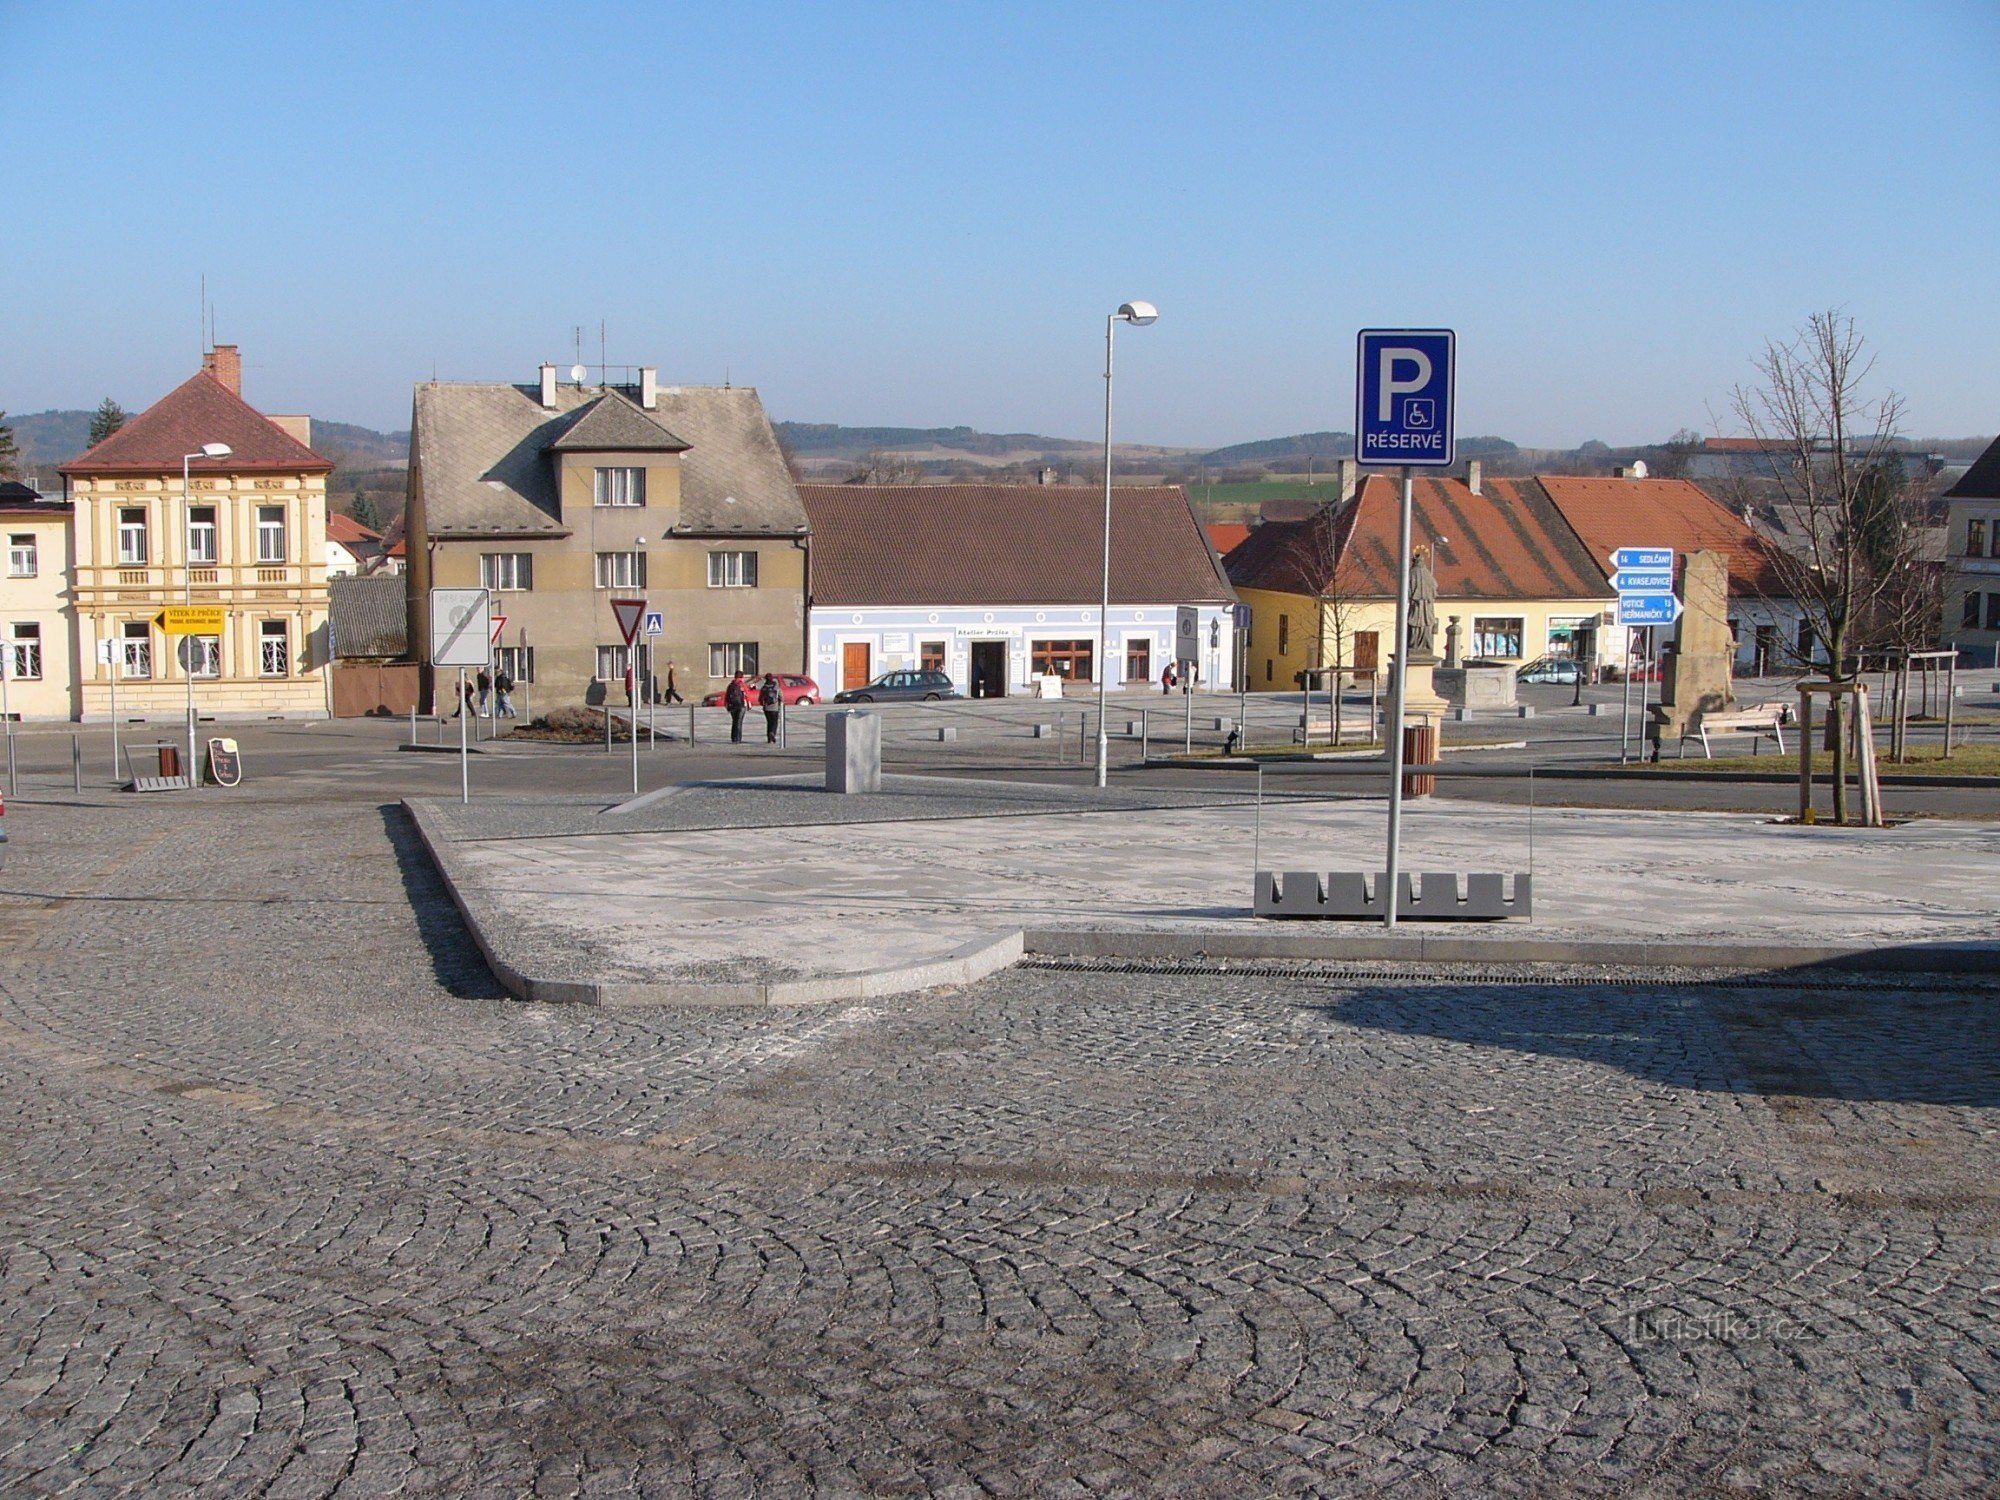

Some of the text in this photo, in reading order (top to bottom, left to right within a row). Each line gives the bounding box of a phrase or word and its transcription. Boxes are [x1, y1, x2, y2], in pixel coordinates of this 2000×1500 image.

[1378, 347, 1432, 422] P
[1366, 429, 1442, 449] RÉSERVÉ
[1621, 553, 1670, 564] 14 SEDLČANY
[1627, 577, 1670, 585] KVASEJOVICE
[1622, 600, 1645, 608] VOTICE
[1621, 609, 1663, 618] HEŘMANIČKY
